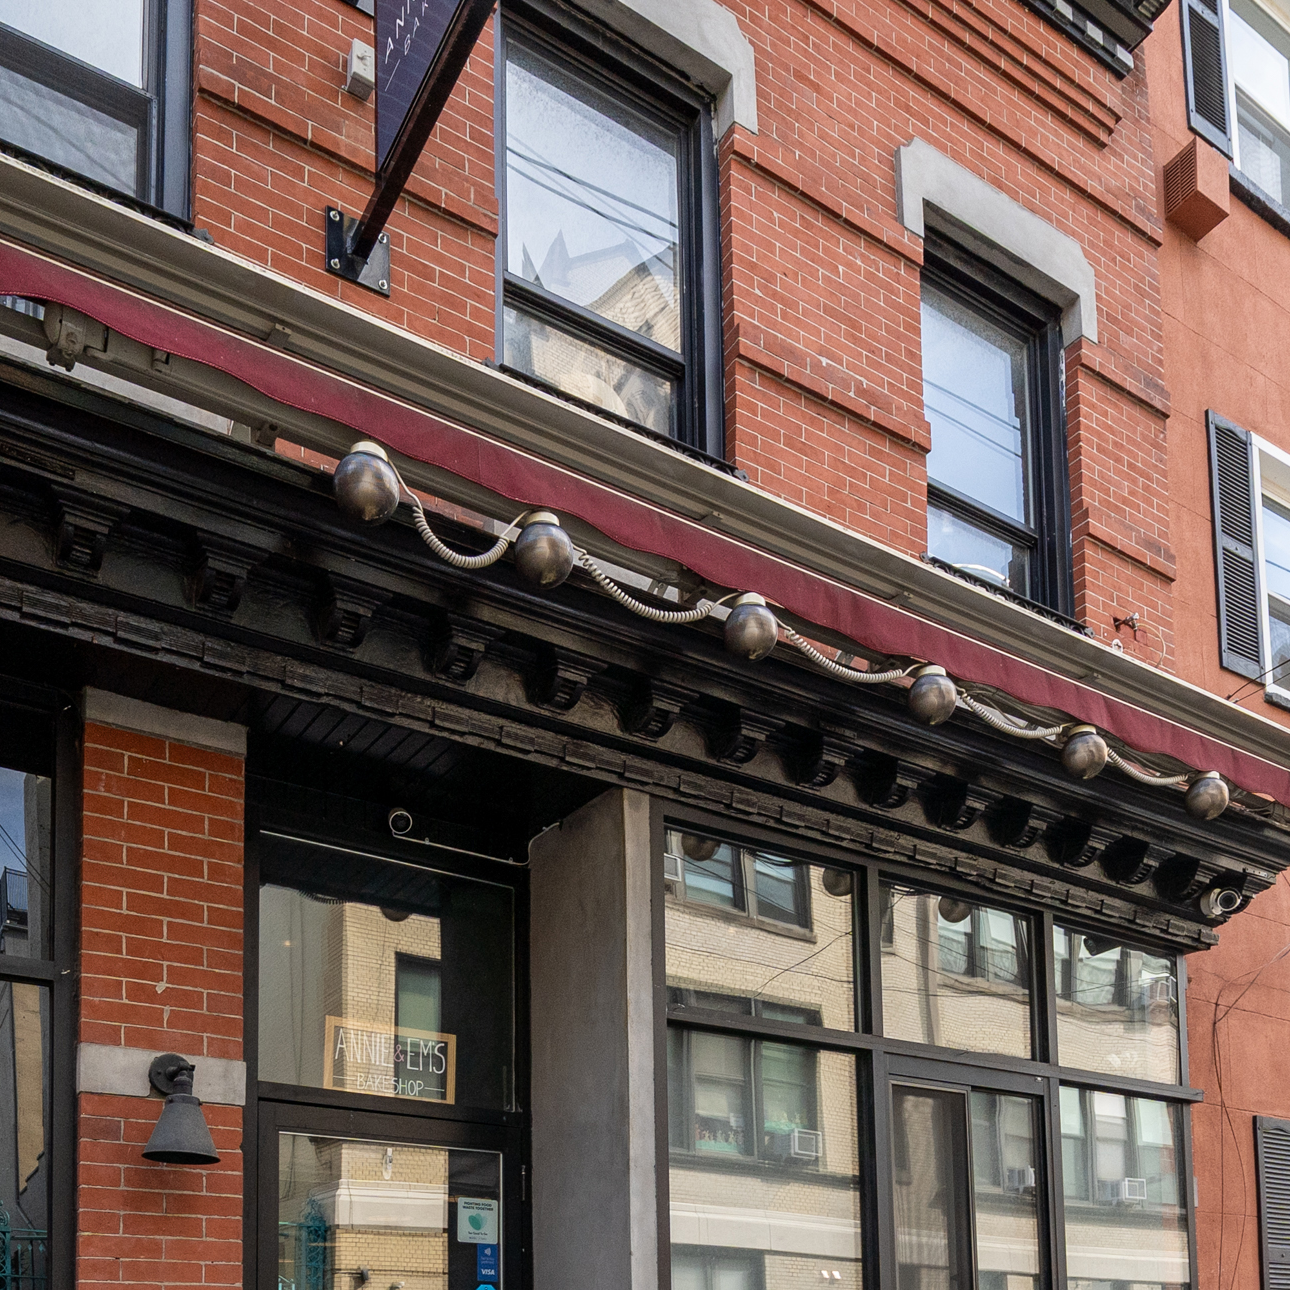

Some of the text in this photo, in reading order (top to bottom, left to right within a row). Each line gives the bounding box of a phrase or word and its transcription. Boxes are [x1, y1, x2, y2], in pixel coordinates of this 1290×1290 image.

[334, 1028, 446, 1074] ANNIE & EM'S
[356, 1072, 424, 1096] BAKESHOP
